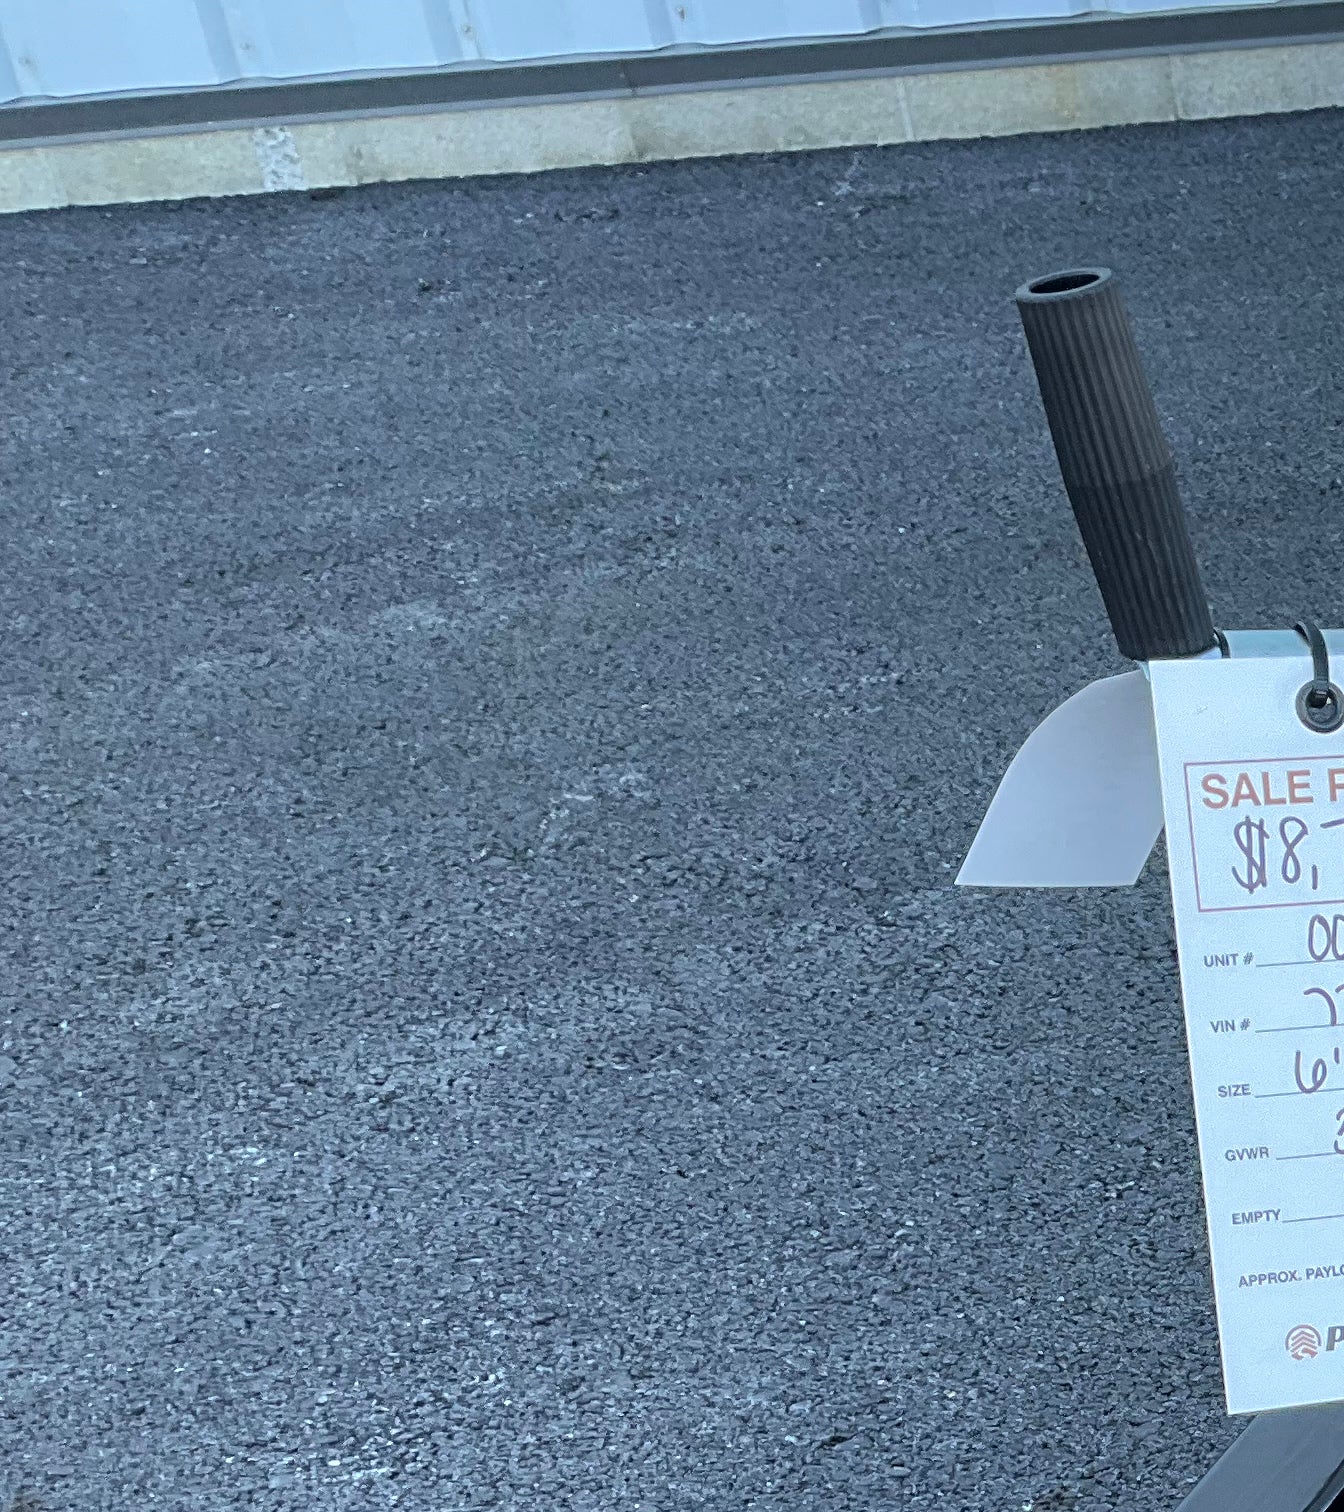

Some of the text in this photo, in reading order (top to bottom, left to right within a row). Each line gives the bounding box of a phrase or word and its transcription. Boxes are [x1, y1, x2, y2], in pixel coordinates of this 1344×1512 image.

[1201, 769, 1314, 809] SALE
[1203, 952, 1240, 968] UNIT
[1242, 951, 1254, 966] #
[1210, 1018, 1237, 1033] VIN
[1239, 1017, 1251, 1031] #
[1217, 1084, 1252, 1099] SIZE
[1225, 1146, 1270, 1162] GVWR
[1231, 1208, 1282, 1226] EMPTY
[1238, 1270, 1302, 1288] APPROX.
